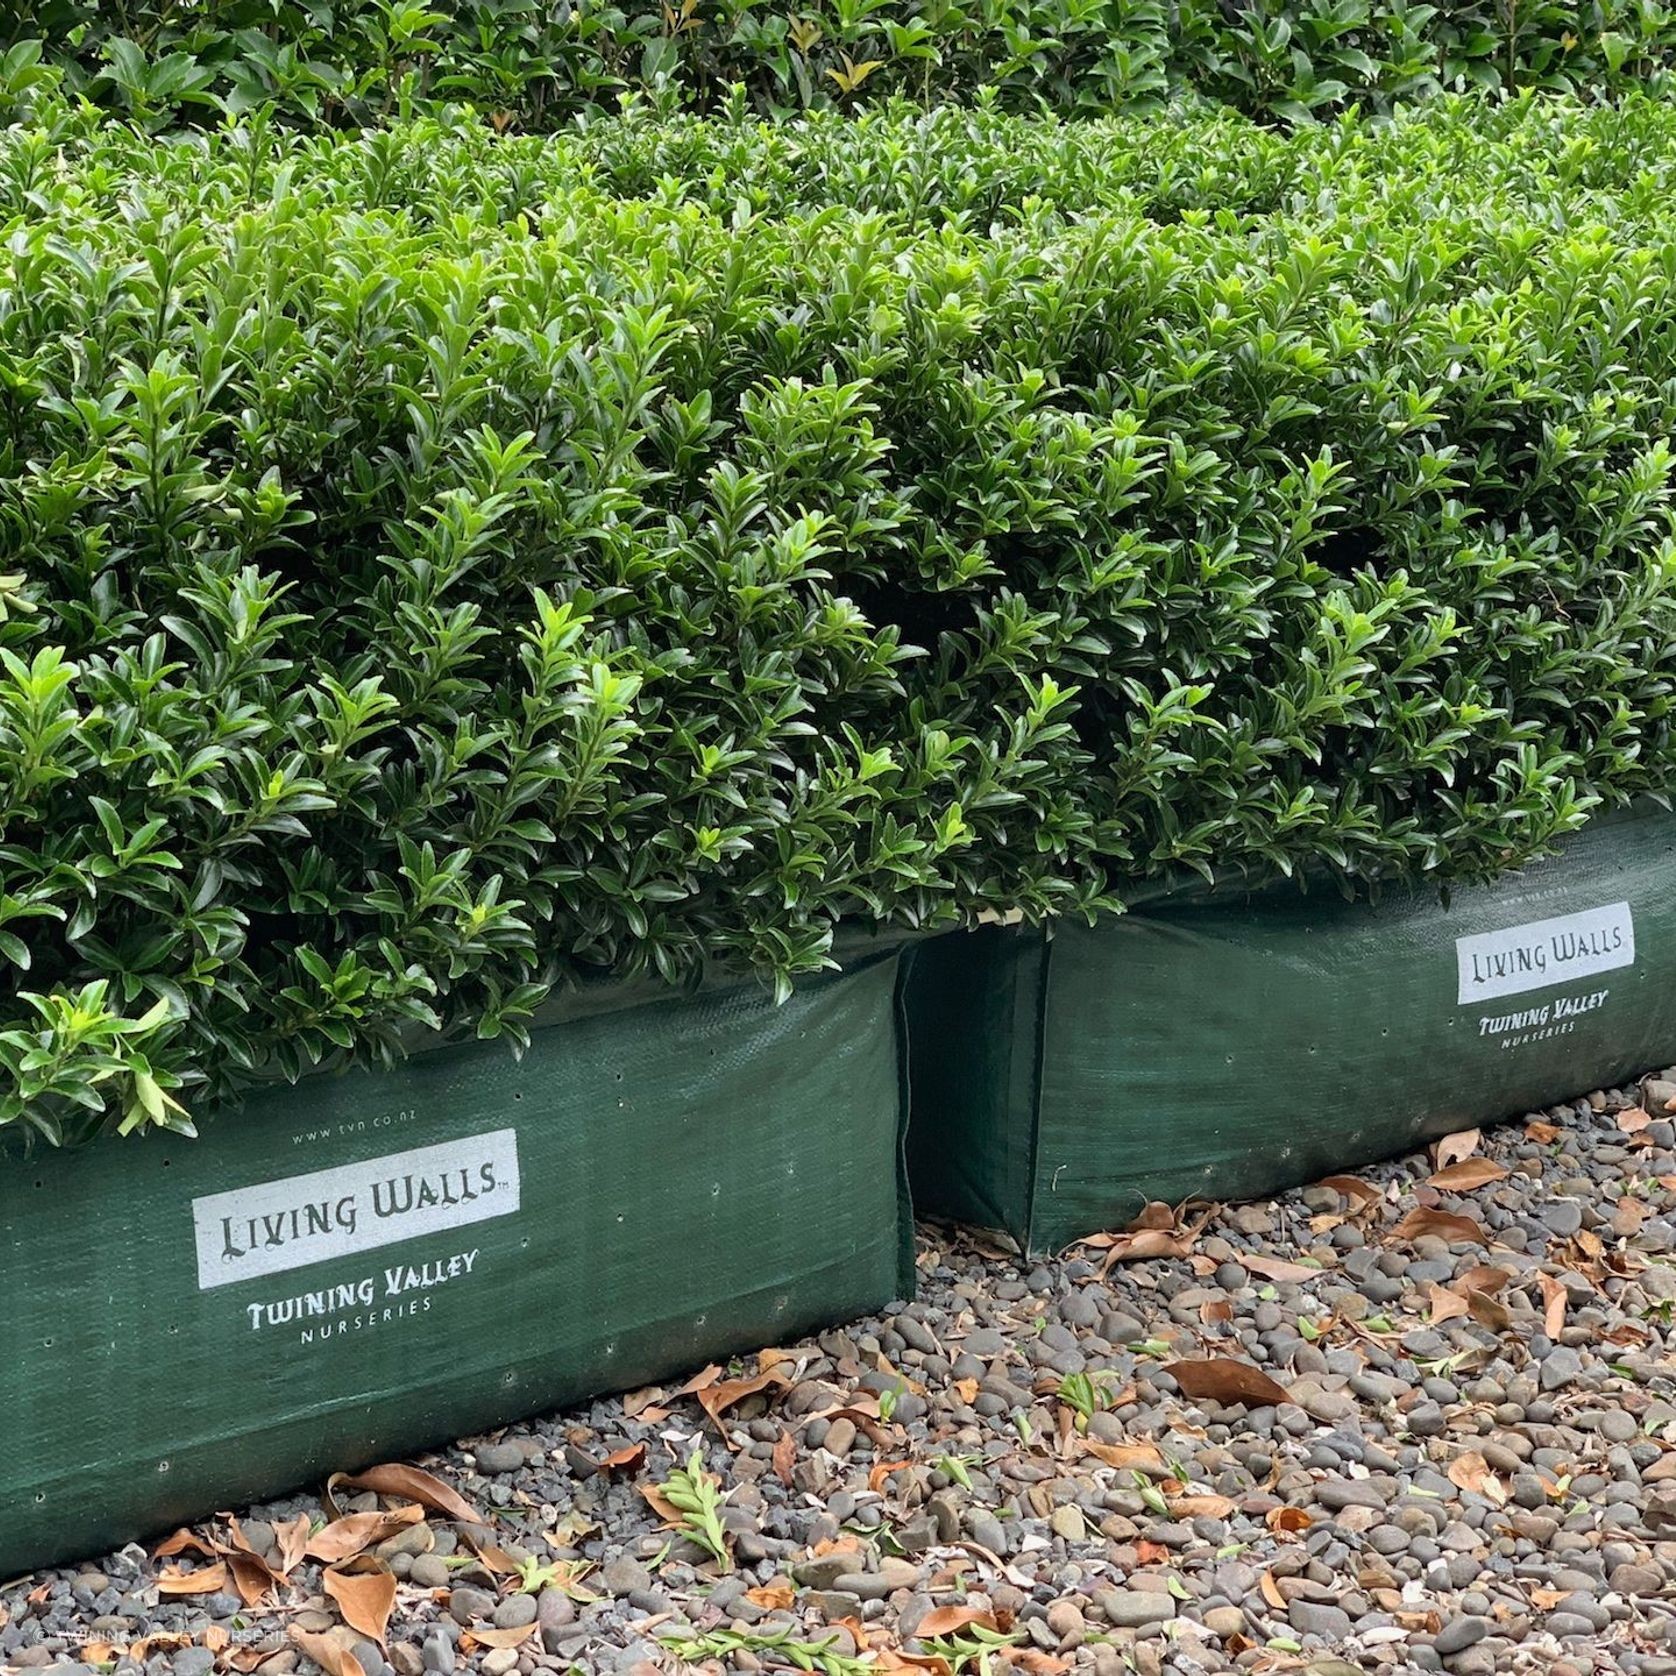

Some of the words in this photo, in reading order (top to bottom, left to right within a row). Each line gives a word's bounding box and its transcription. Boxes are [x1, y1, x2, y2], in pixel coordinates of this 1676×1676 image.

[1472, 945, 1546, 984] LIVING
[1551, 926, 1622, 963] WALLS
[1478, 1004, 1550, 1037] TWINING
[1553, 989, 1609, 1020] VALLEY
[1501, 1021, 1576, 1049] NURSERIES
[292, 1109, 417, 1144] wwwtvnco.nz
[221, 1194, 358, 1265] LIVING
[370, 1161, 496, 1219] WALLS
[246, 1278, 376, 1330] TWINING
[384, 1248, 480, 1297] VALLEY
[300, 1296, 432, 1345] NURSERIES
